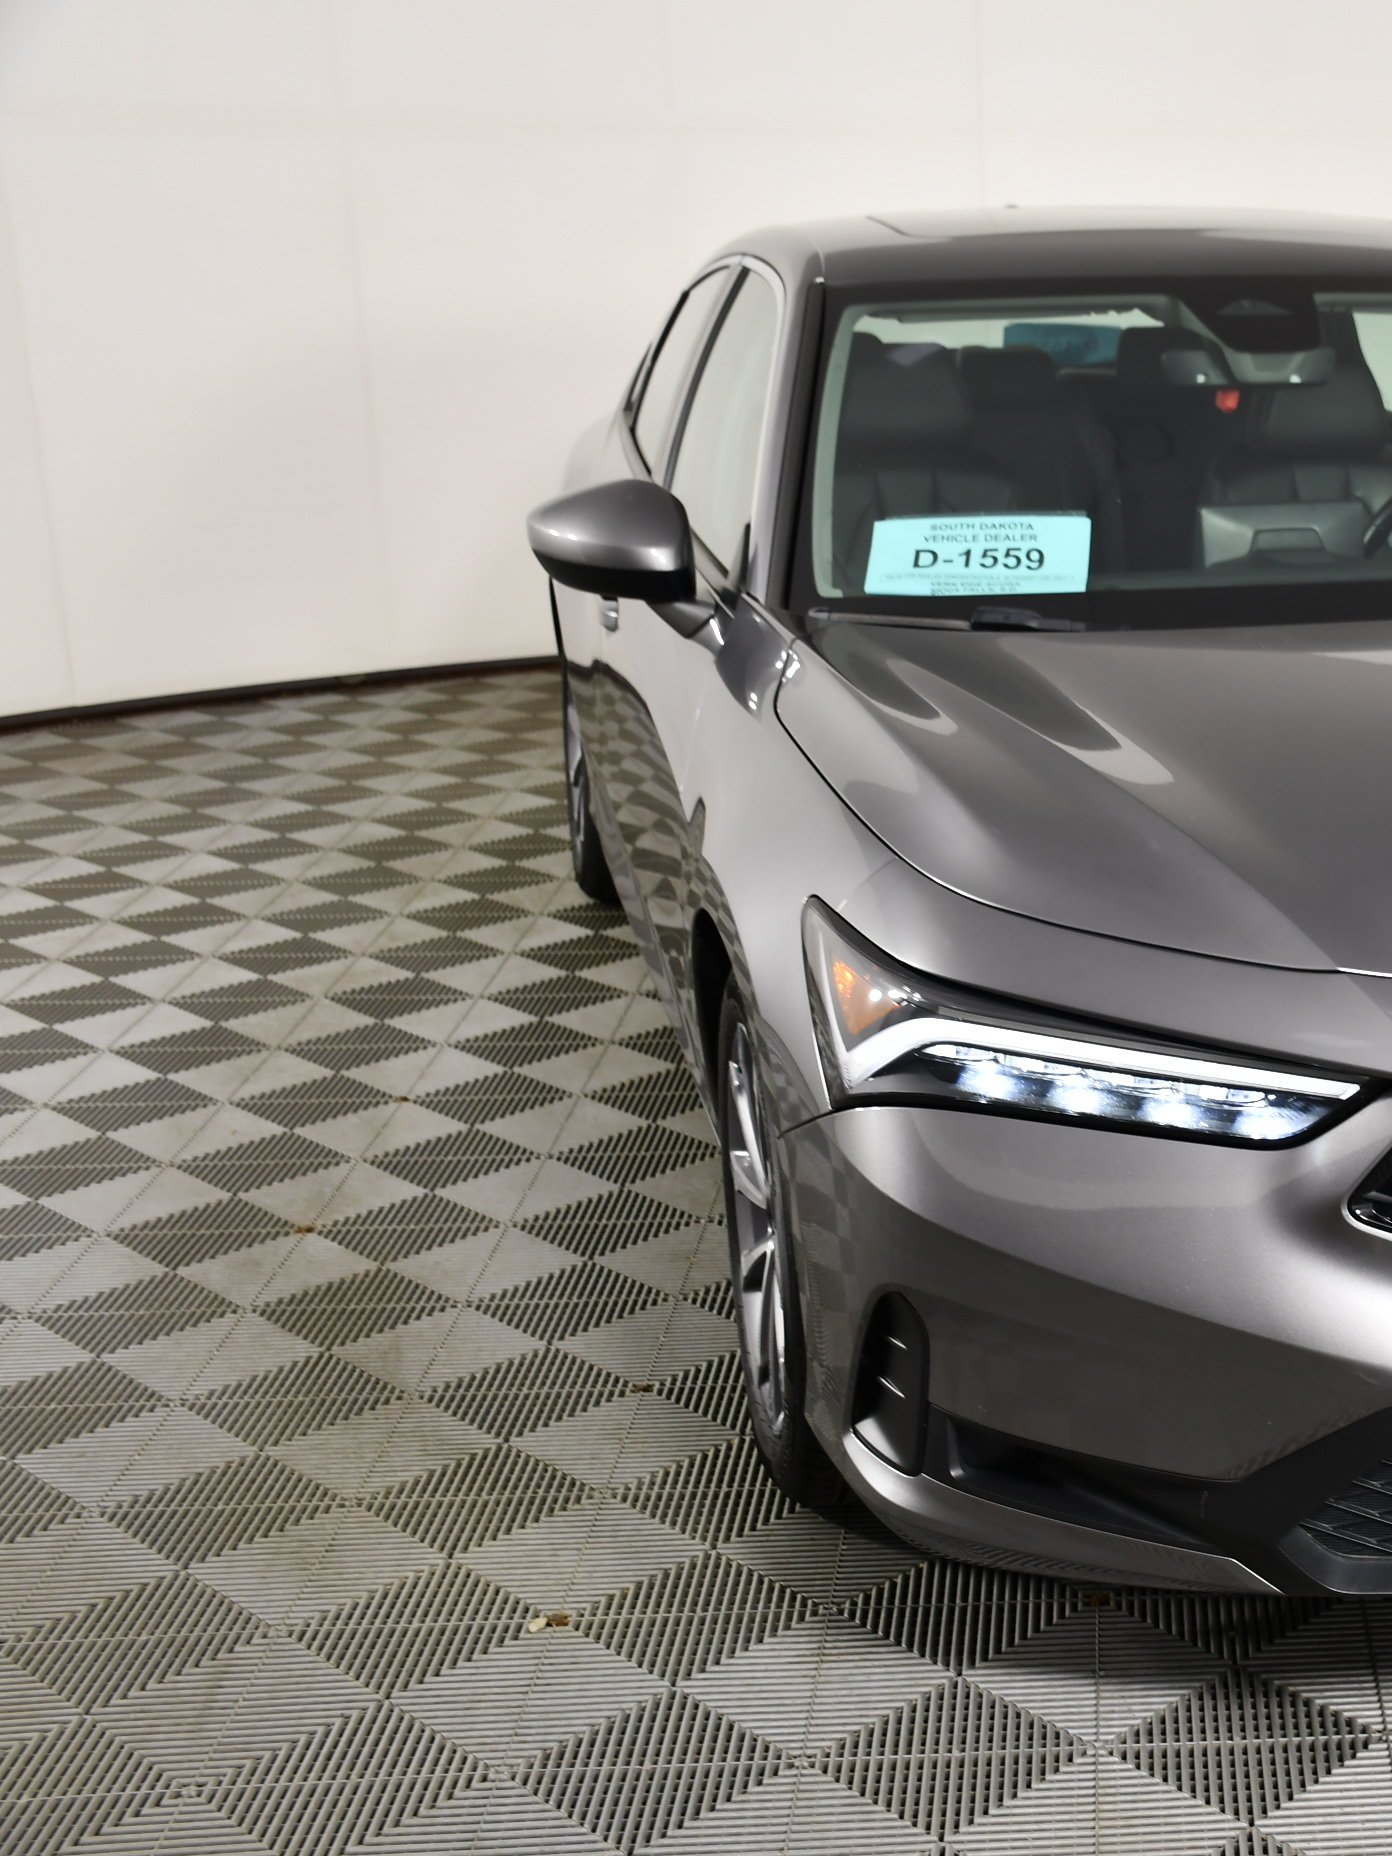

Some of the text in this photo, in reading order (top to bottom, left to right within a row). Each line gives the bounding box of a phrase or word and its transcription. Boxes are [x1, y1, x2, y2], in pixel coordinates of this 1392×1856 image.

[930, 522, 1035, 531] SOUTH DAKOTA
[923, 533, 1038, 543] VEHICLE DEALER
[912, 548, 1046, 571] D-1559
